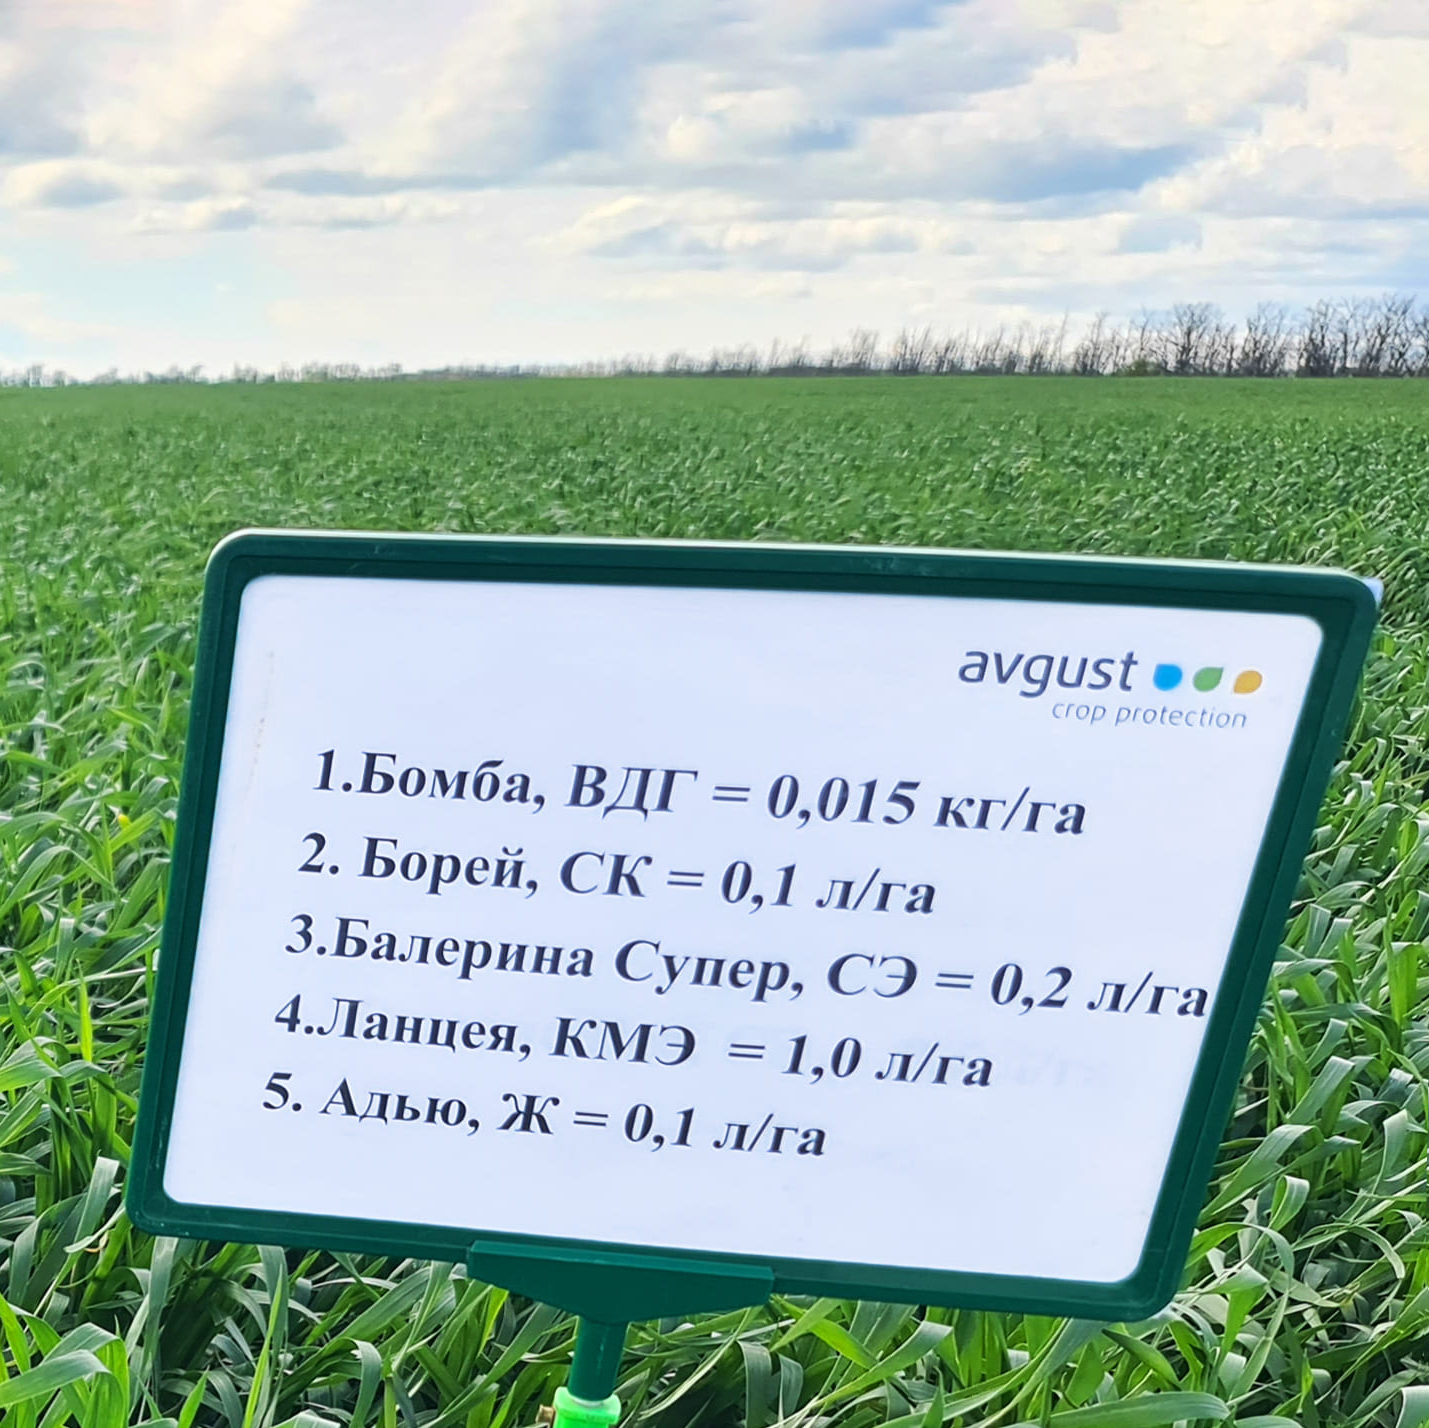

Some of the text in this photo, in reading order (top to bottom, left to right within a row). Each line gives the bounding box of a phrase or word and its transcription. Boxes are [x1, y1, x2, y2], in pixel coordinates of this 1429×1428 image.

[958, 650, 1138, 698] avgust
[1052, 702, 1247, 729] crop protection
[313, 748, 1087, 835] 1.Бомба, ВДГ = 0,015 кг/га
[297, 832, 936, 915] 2. Борей, СК = 0,1 л/га
[285, 913, 1210, 1018] 3.Балерина Супер, СЭ = 0,2 л/га
[274, 993, 531, 1062] 4.Ланцея,
[549, 1017, 697, 1066] КМЭ
[727, 1043, 766, 1060] =
[781, 1034, 862, 1085] 1,0
[874, 1042, 994, 1087] л/га
[262, 1071, 827, 1157] 5. Адью, Ж = 0,1 л/га
